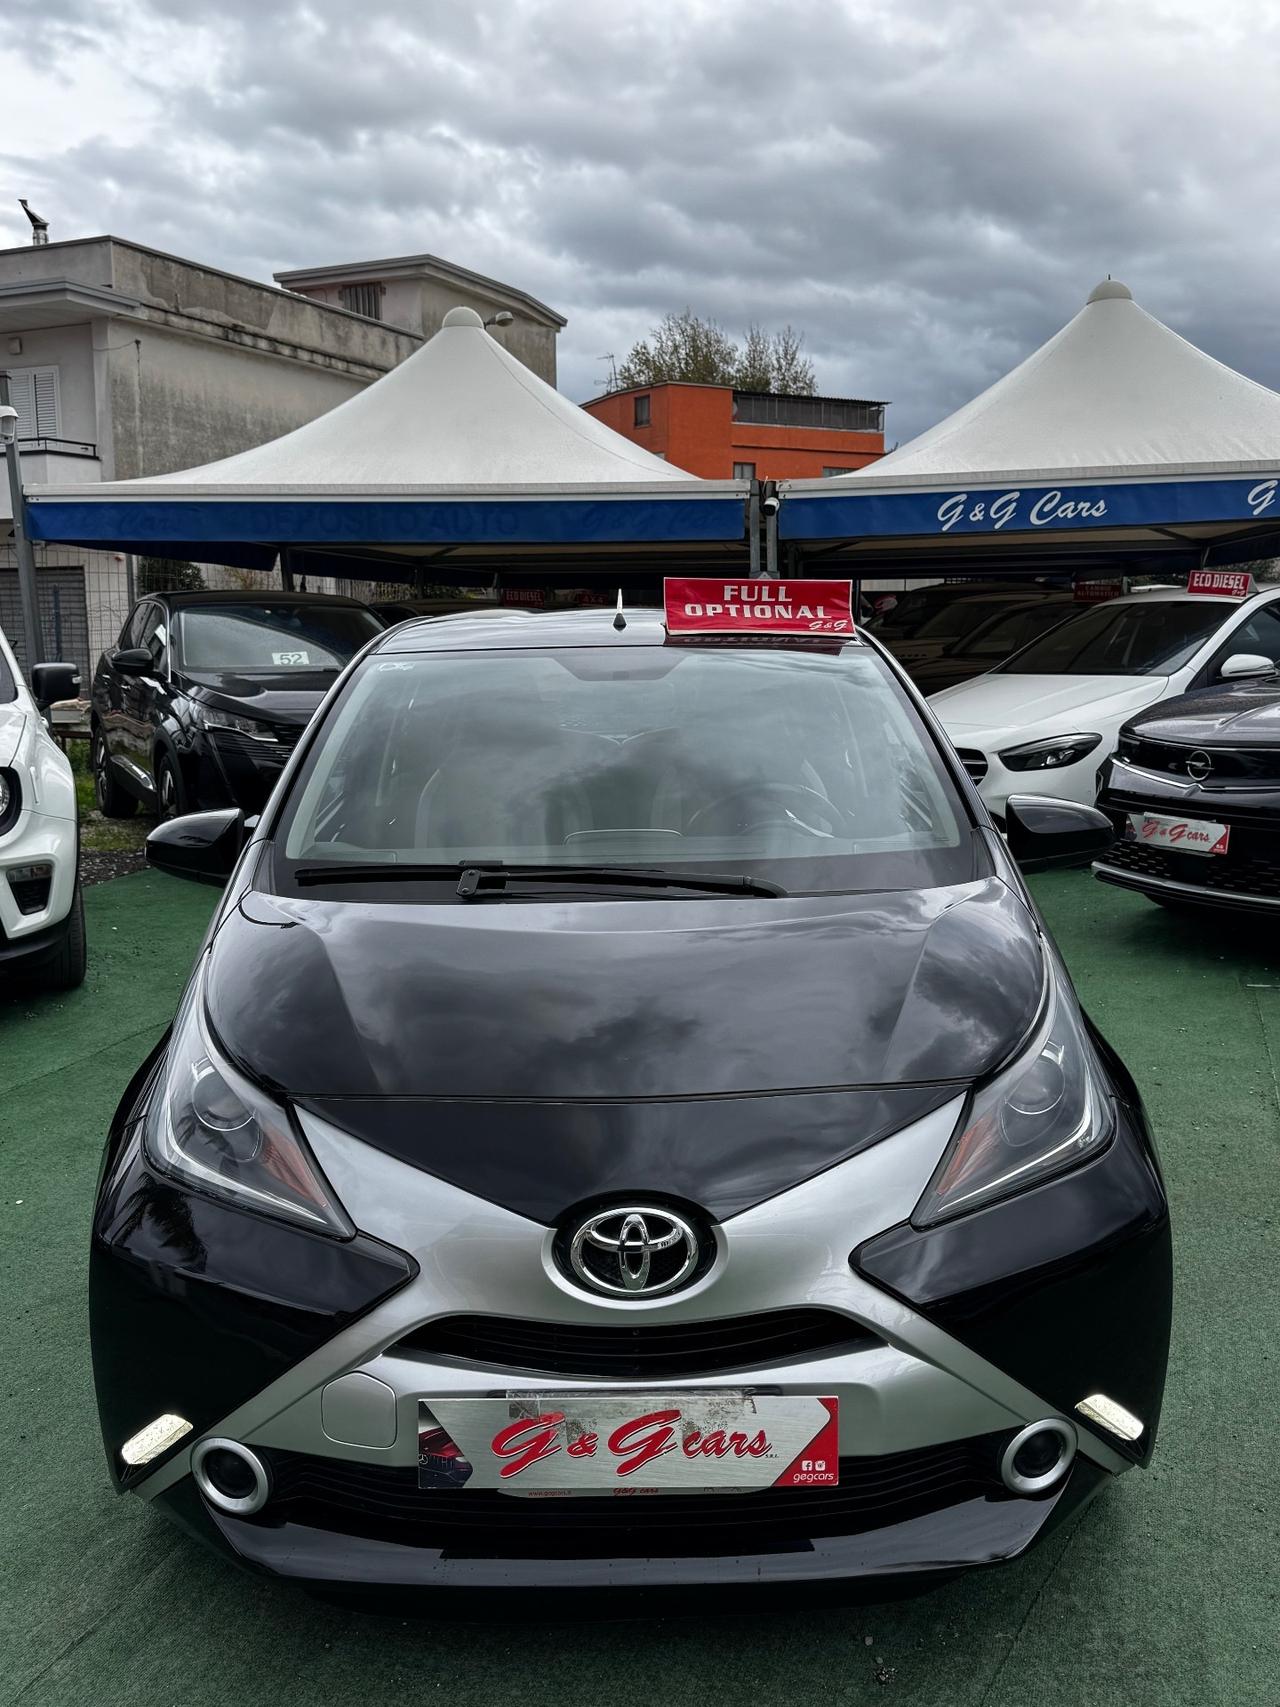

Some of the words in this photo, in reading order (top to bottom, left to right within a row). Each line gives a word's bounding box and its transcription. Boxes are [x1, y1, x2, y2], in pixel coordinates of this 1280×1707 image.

[1029, 491, 1108, 526] Cars
[1193, 573, 1212, 588] ECO
[1213, 574, 1246, 590] DIESEL
[506, 590, 520, 601] ECO
[520, 591, 543, 602] DIESEL
[723, 585, 793, 602] FULL
[684, 603, 832, 619] OPTIONAL
[280, 654, 303, 666] 52
[1187, 831, 1210, 842] cars
[682, 1429, 773, 1459] cars
[793, 1472, 834, 1483] gegcars
